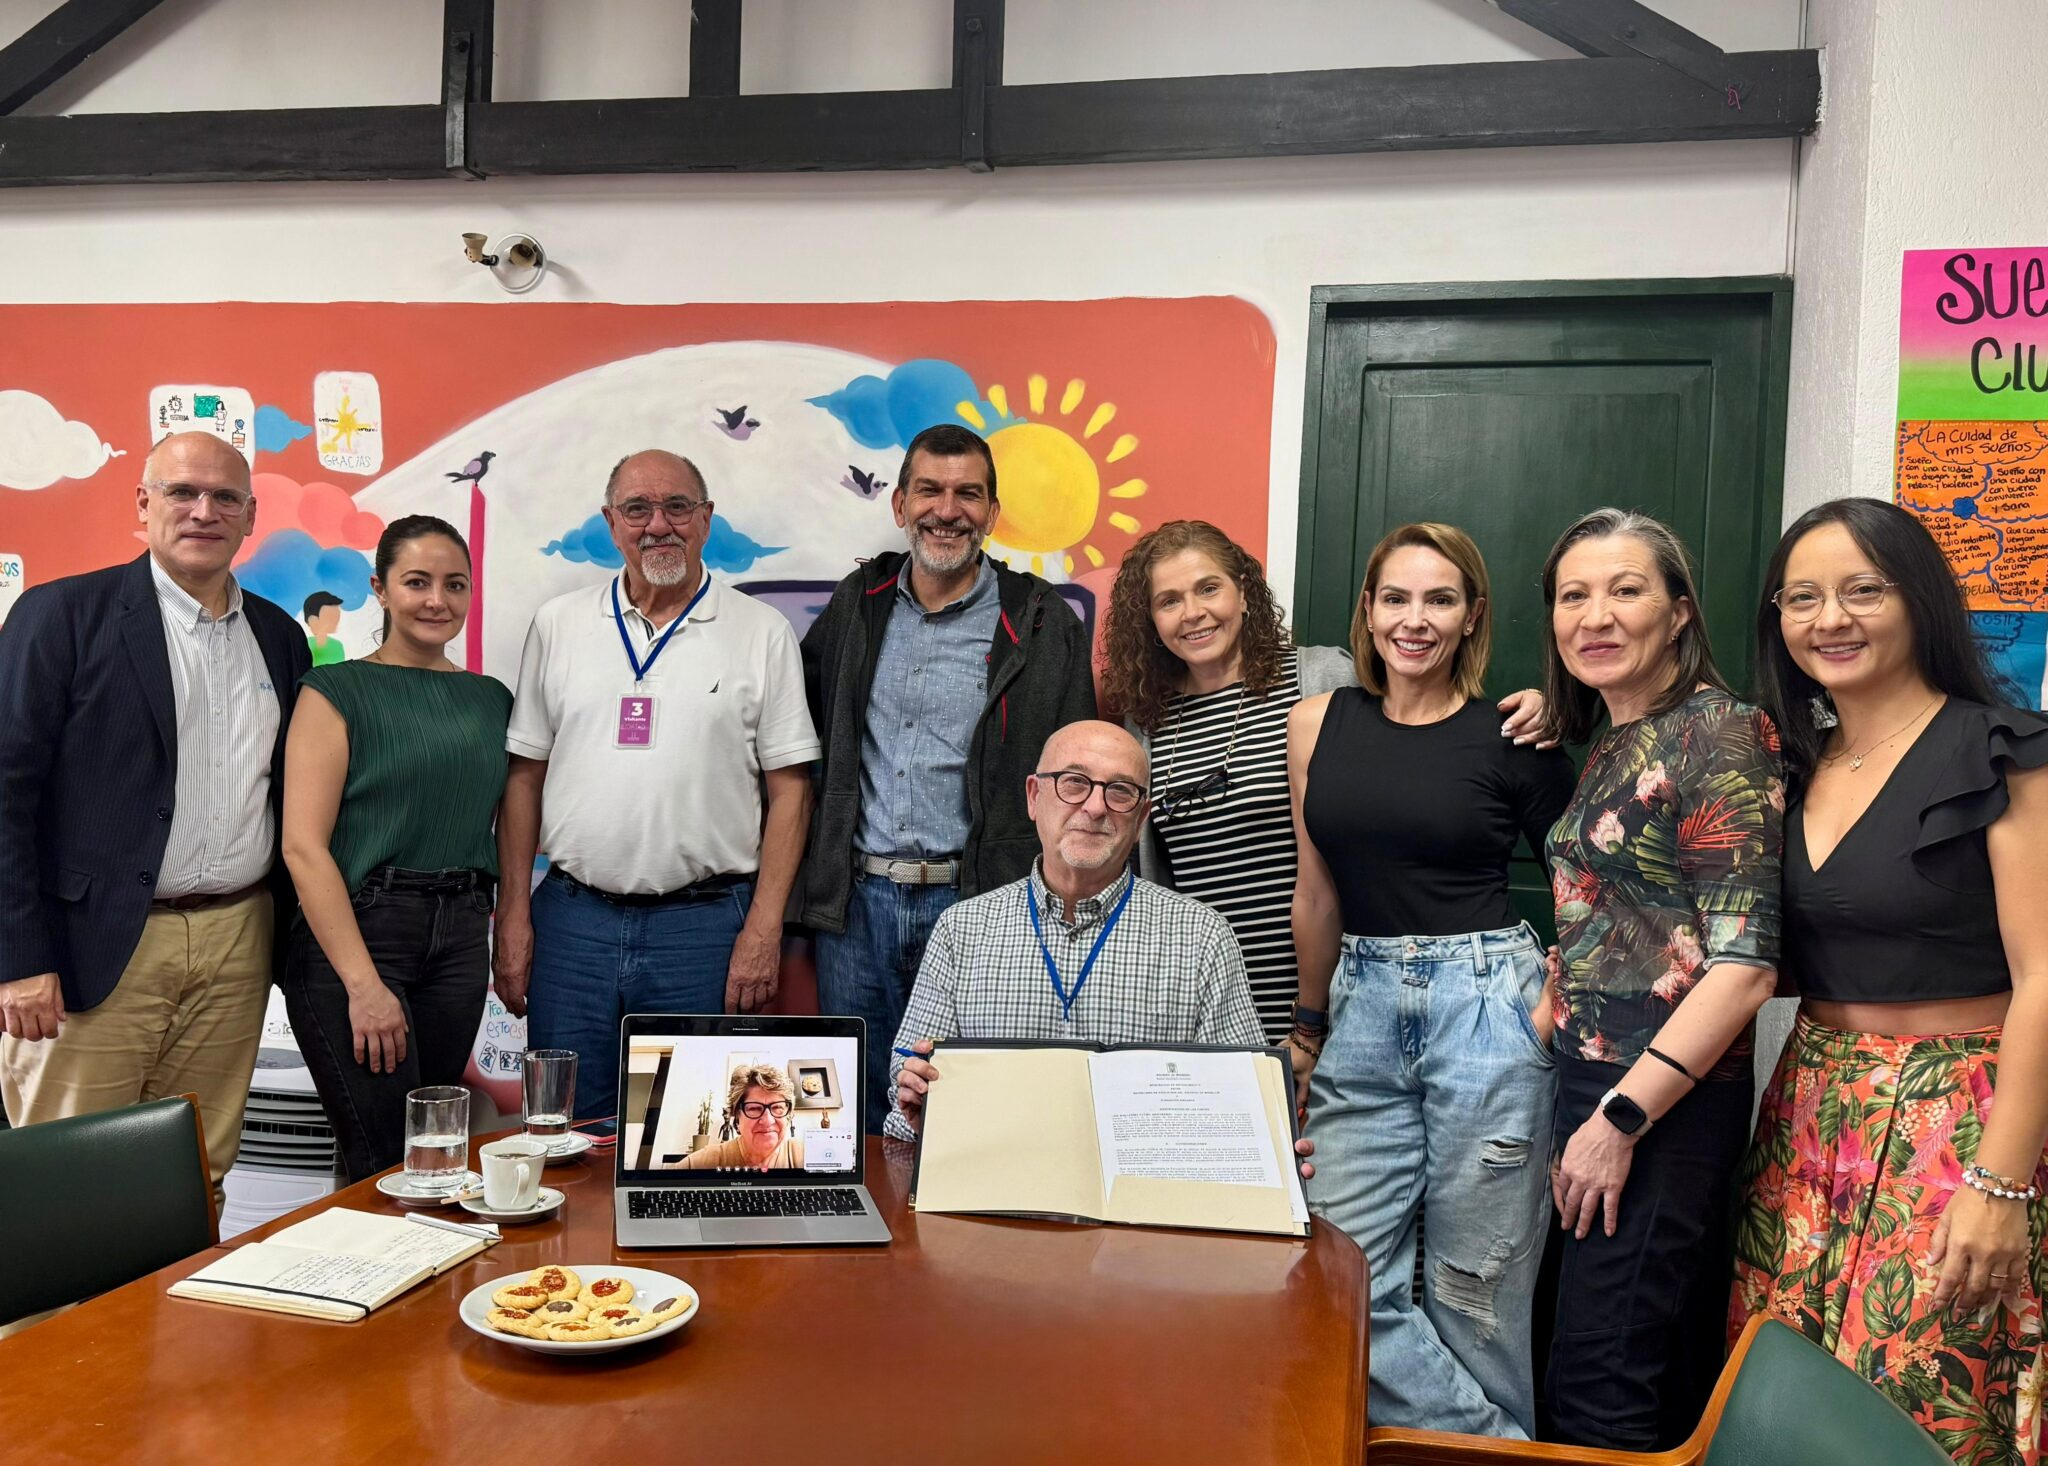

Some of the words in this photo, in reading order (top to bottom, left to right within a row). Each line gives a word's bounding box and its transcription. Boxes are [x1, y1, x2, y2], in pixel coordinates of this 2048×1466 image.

[1926, 430, 1946, 443] LA
[2000, 429, 2017, 441] de
[324, 454, 371, 468] GRACIAS
[631, 702, 643, 717] 3
